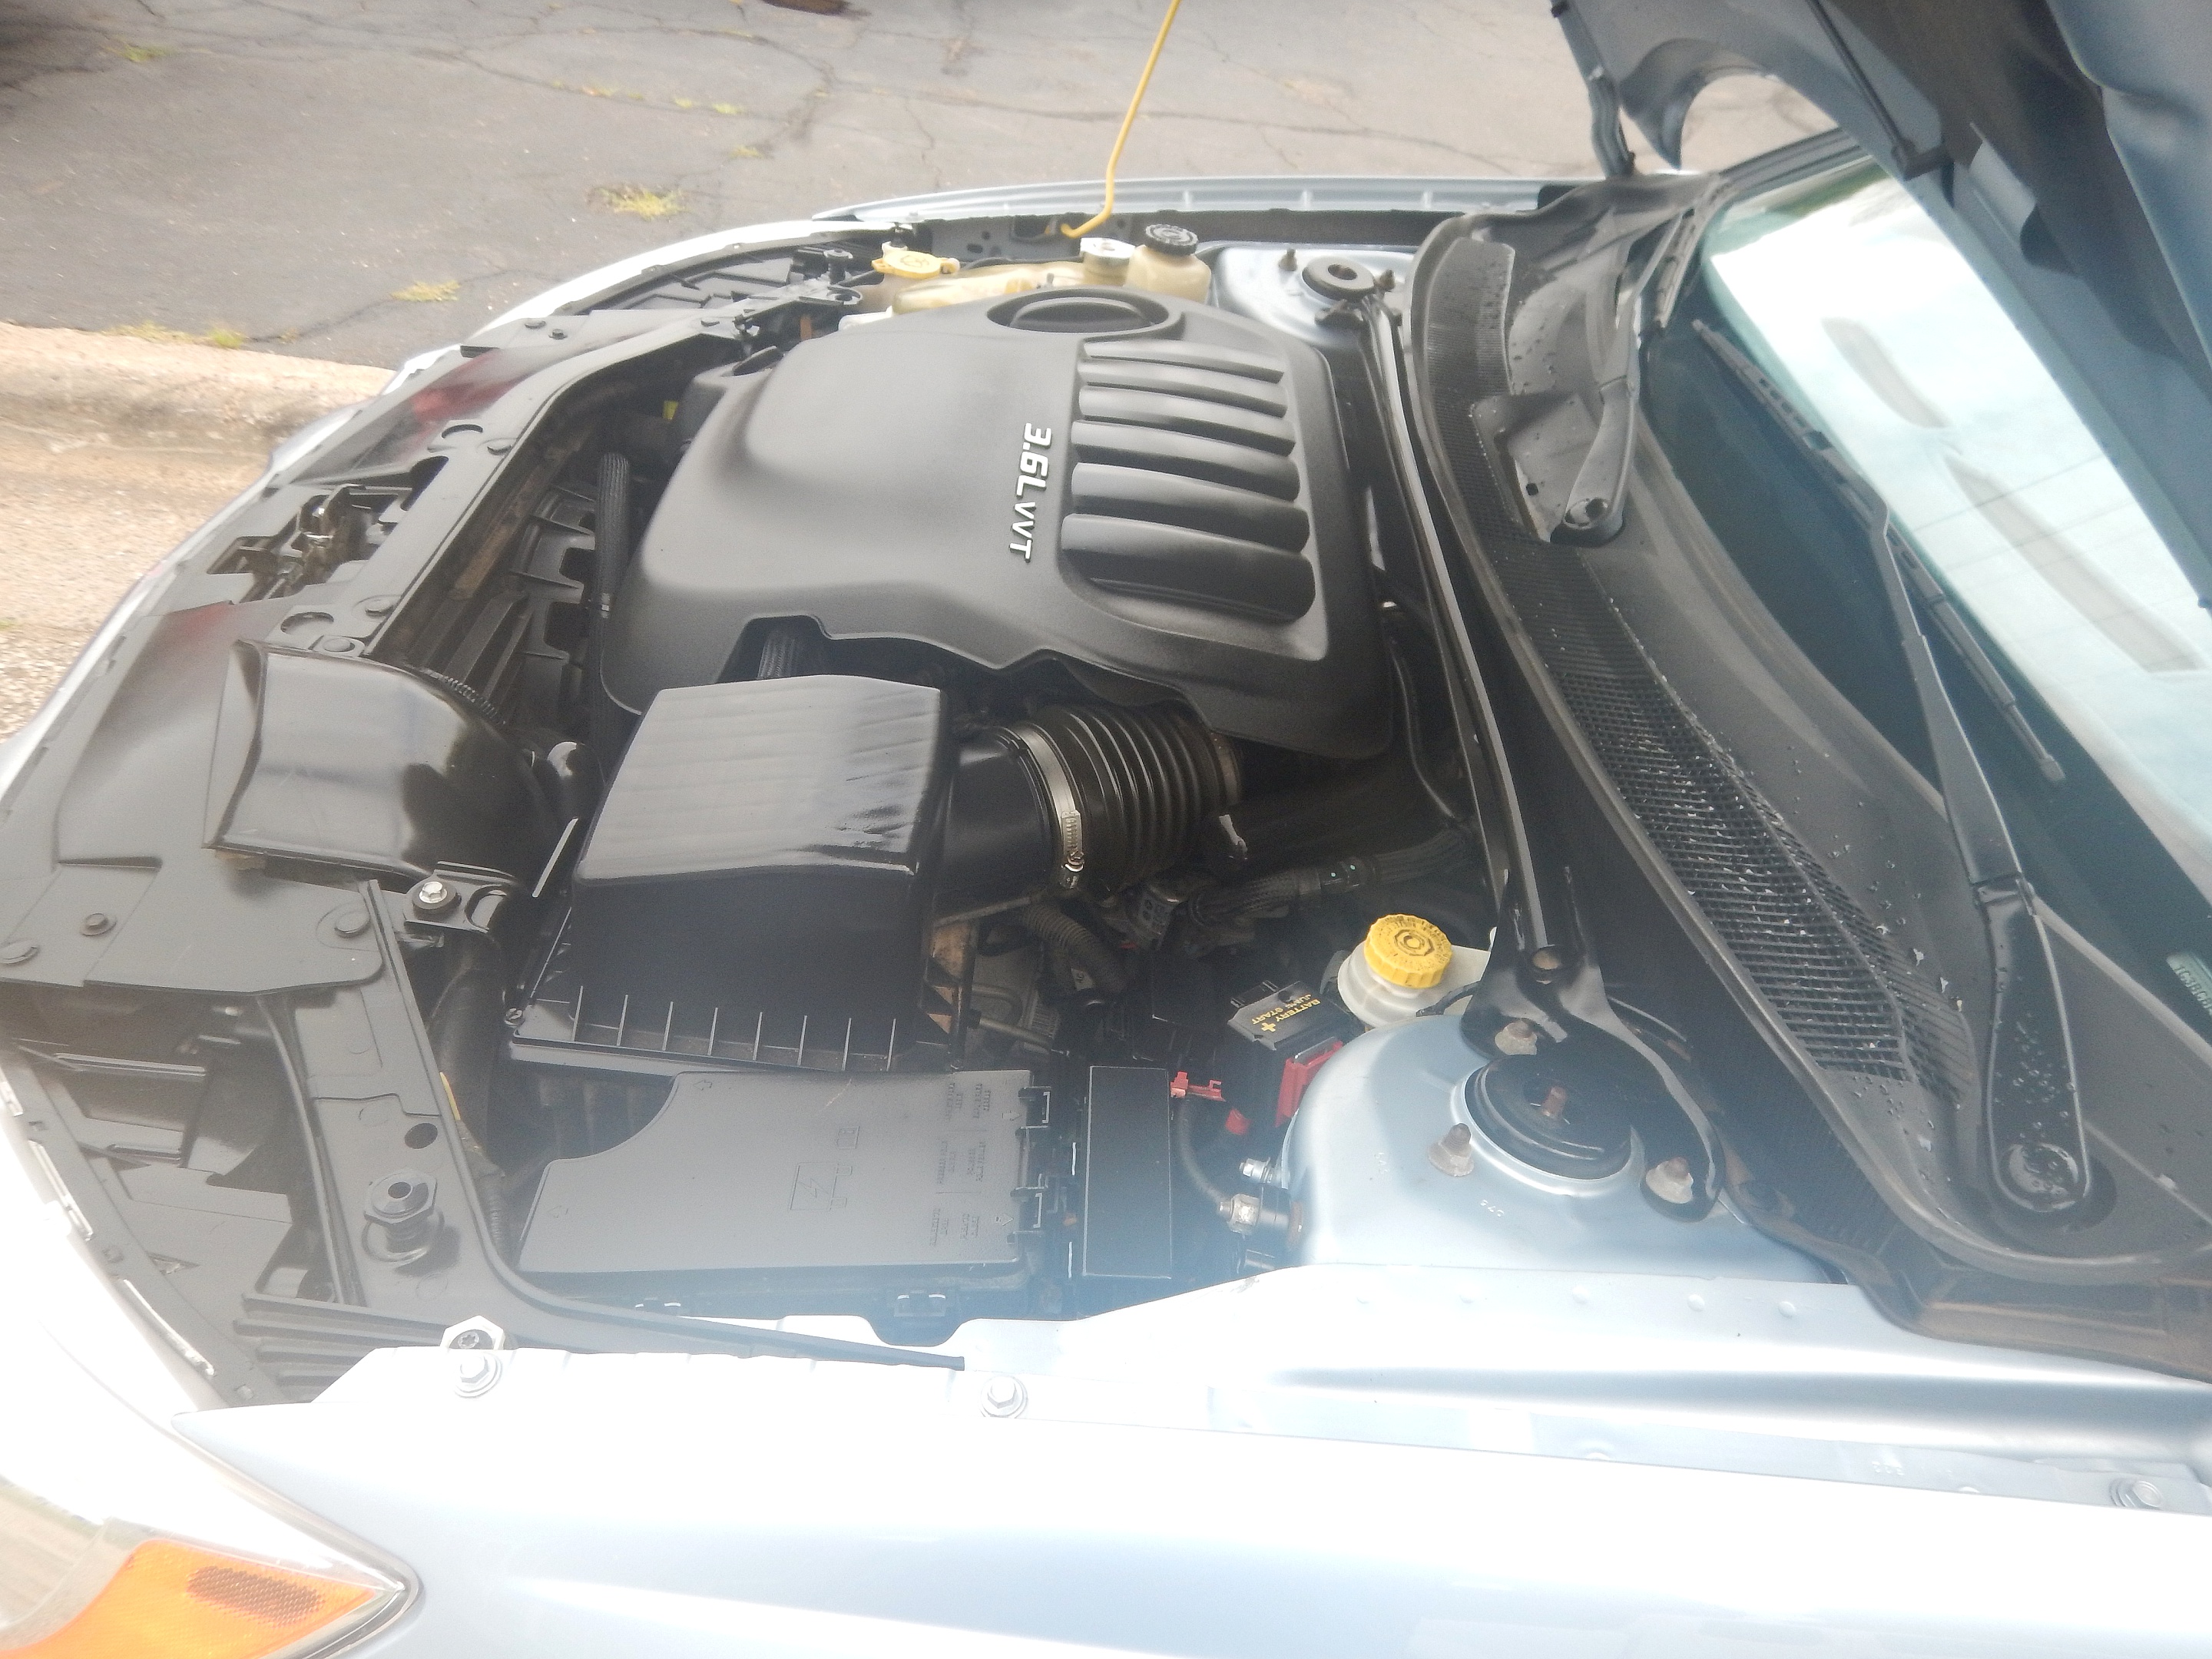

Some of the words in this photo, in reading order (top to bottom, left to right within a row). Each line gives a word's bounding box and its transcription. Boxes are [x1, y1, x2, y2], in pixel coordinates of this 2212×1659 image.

[1016, 422, 1051, 498] 3.6L
[1009, 502, 1036, 562] VVT
[1275, 998, 1321, 1022] BATTERY
[1284, 994, 1312, 1008] JUMP
[1251, 1007, 1283, 1025] START
